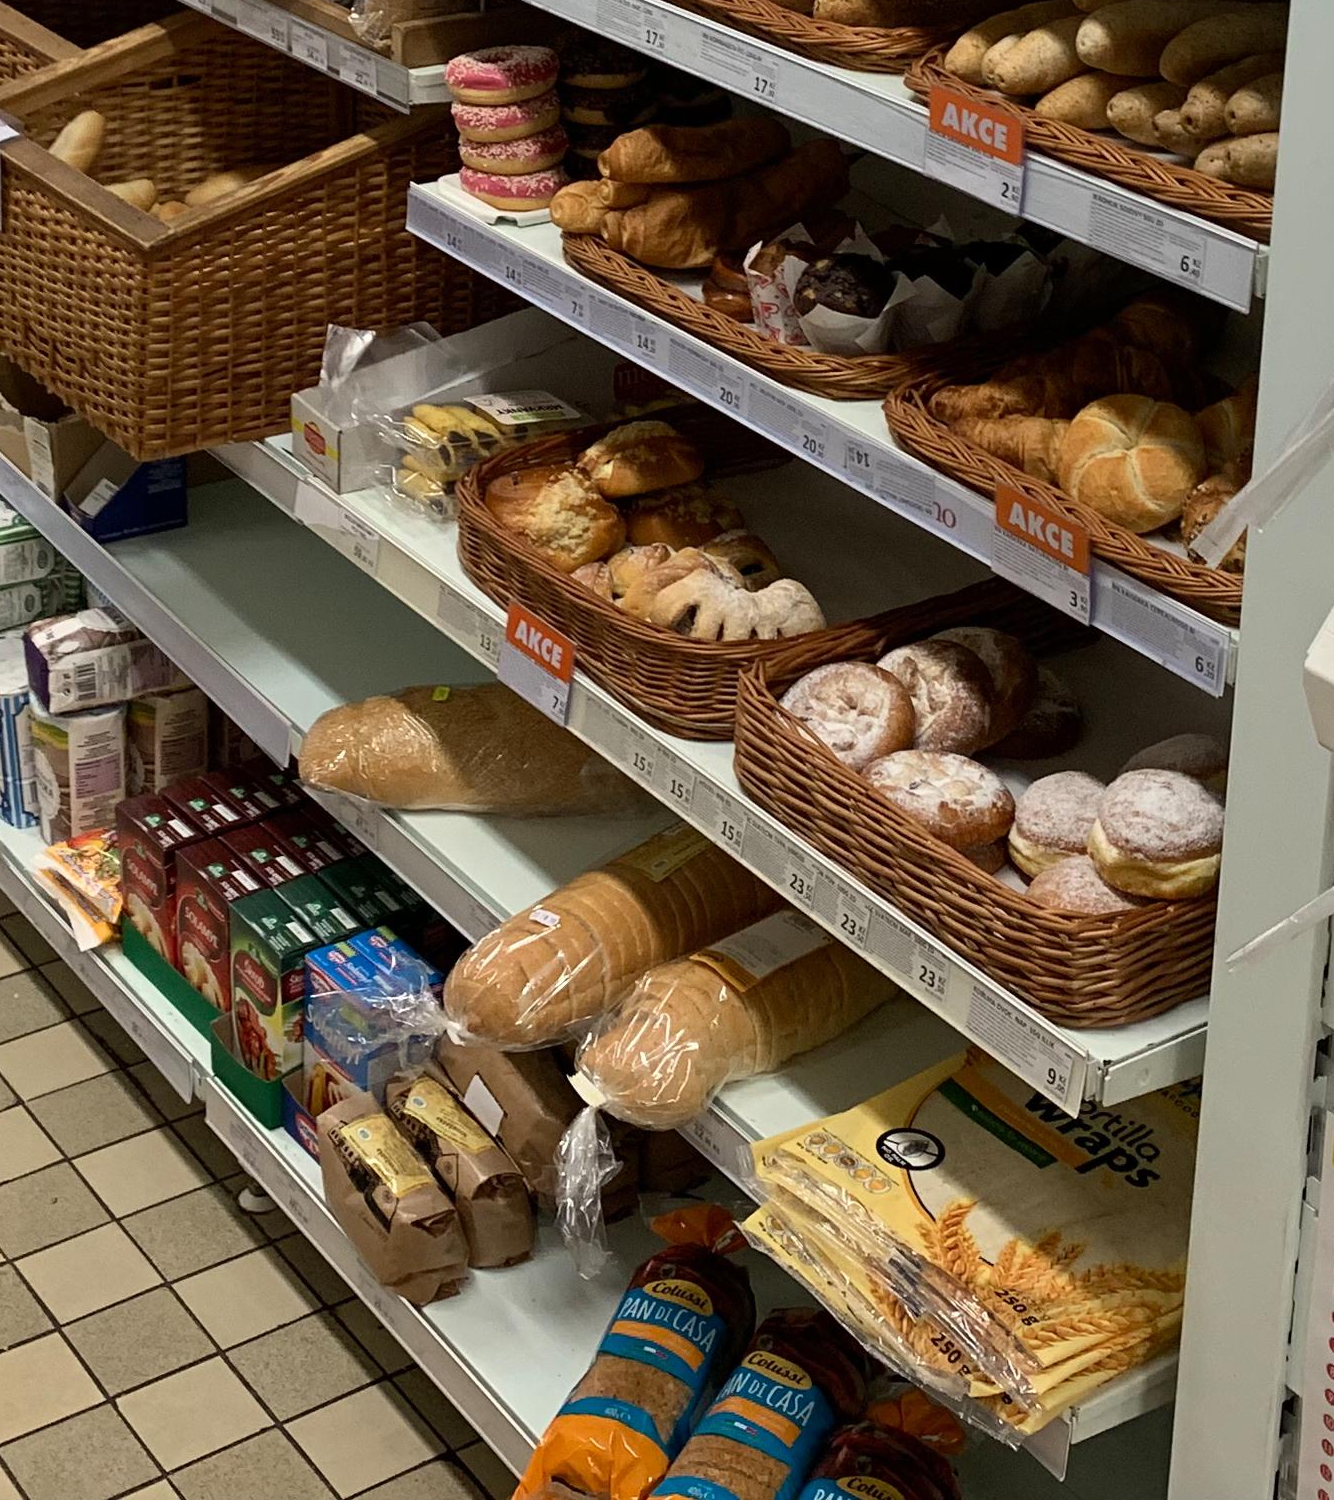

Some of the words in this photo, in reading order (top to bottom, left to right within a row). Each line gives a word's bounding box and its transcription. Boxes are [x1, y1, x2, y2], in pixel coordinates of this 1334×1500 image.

[645, 29, 658, 45] 17
[754, 76, 767, 92] 17
[941, 102, 1008, 152] AKCE
[1000, 181, 1010, 198] 2
[1179, 254, 1190, 272] 6
[636, 334, 649, 349] 14
[719, 387, 734, 405] 20
[802, 434, 817, 452] 20
[1009, 501, 1075, 559] AKCE
[1069, 589, 1079, 608] 3
[479, 633, 492, 651] 13
[514, 619, 564, 670] AKCE
[1194, 655, 1205, 674] 6
[551, 695, 559, 710] 7
[633, 752, 646, 772] 15
[670, 779, 684, 799] 15
[720, 820, 735, 841] 15
[789, 873, 805, 896] 23
[183, 906, 220, 949] SOLAMYL
[840, 913, 857, 936] 23
[919, 964, 935, 988] 23
[1046, 1067, 1056, 1085] 9
[1025, 1093, 1161, 1189] wraps
[1080, 1099, 1160, 1163] ortilla
[651, 1281, 708, 1309] Colussi
[994, 1288, 1027, 1317] 250
[617, 1295, 653, 1320] PAN
[654, 1307, 670, 1323] DI
[672, 1307, 718, 1353] CASA
[930, 1331, 962, 1366] 250
[747, 1351, 806, 1385] Colussi
[749, 1381, 766, 1398] DI
[766, 1386, 816, 1428] CASA
